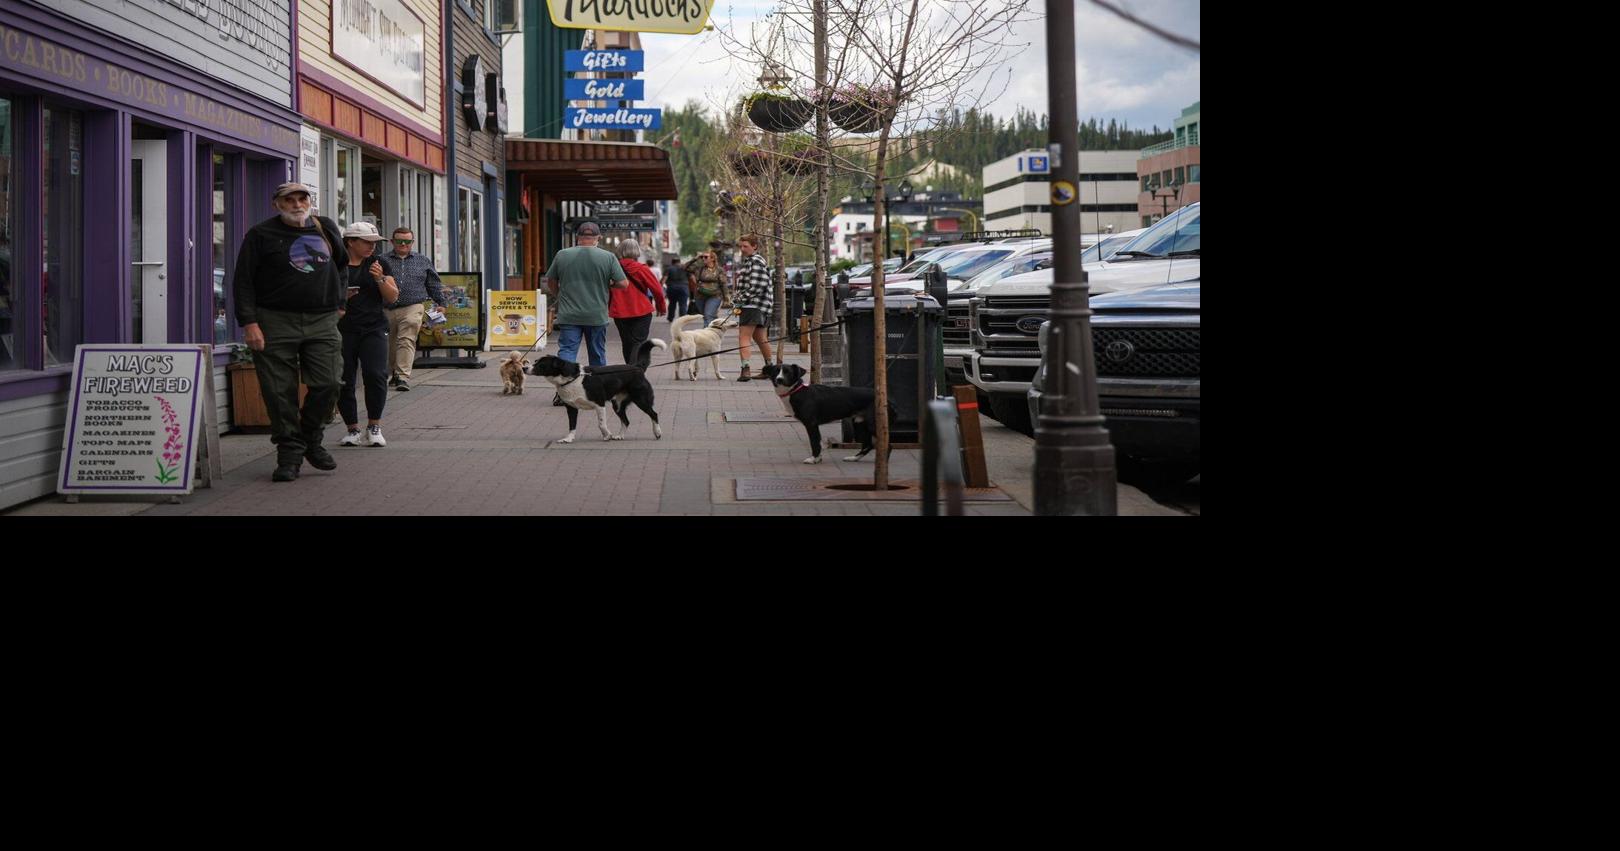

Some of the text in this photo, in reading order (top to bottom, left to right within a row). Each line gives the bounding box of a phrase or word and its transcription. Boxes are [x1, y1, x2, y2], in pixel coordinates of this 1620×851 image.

[0, 28, 87, 83] CARDS
[106, 64, 168, 107] BOOKS
[184, 92, 261, 139] MAGAZINES
[584, 80, 625, 99] Gold
[573, 109, 653, 128] Jewellery
[107, 355, 174, 375] MAC'S
[84, 377, 191, 396] FIREWEED
